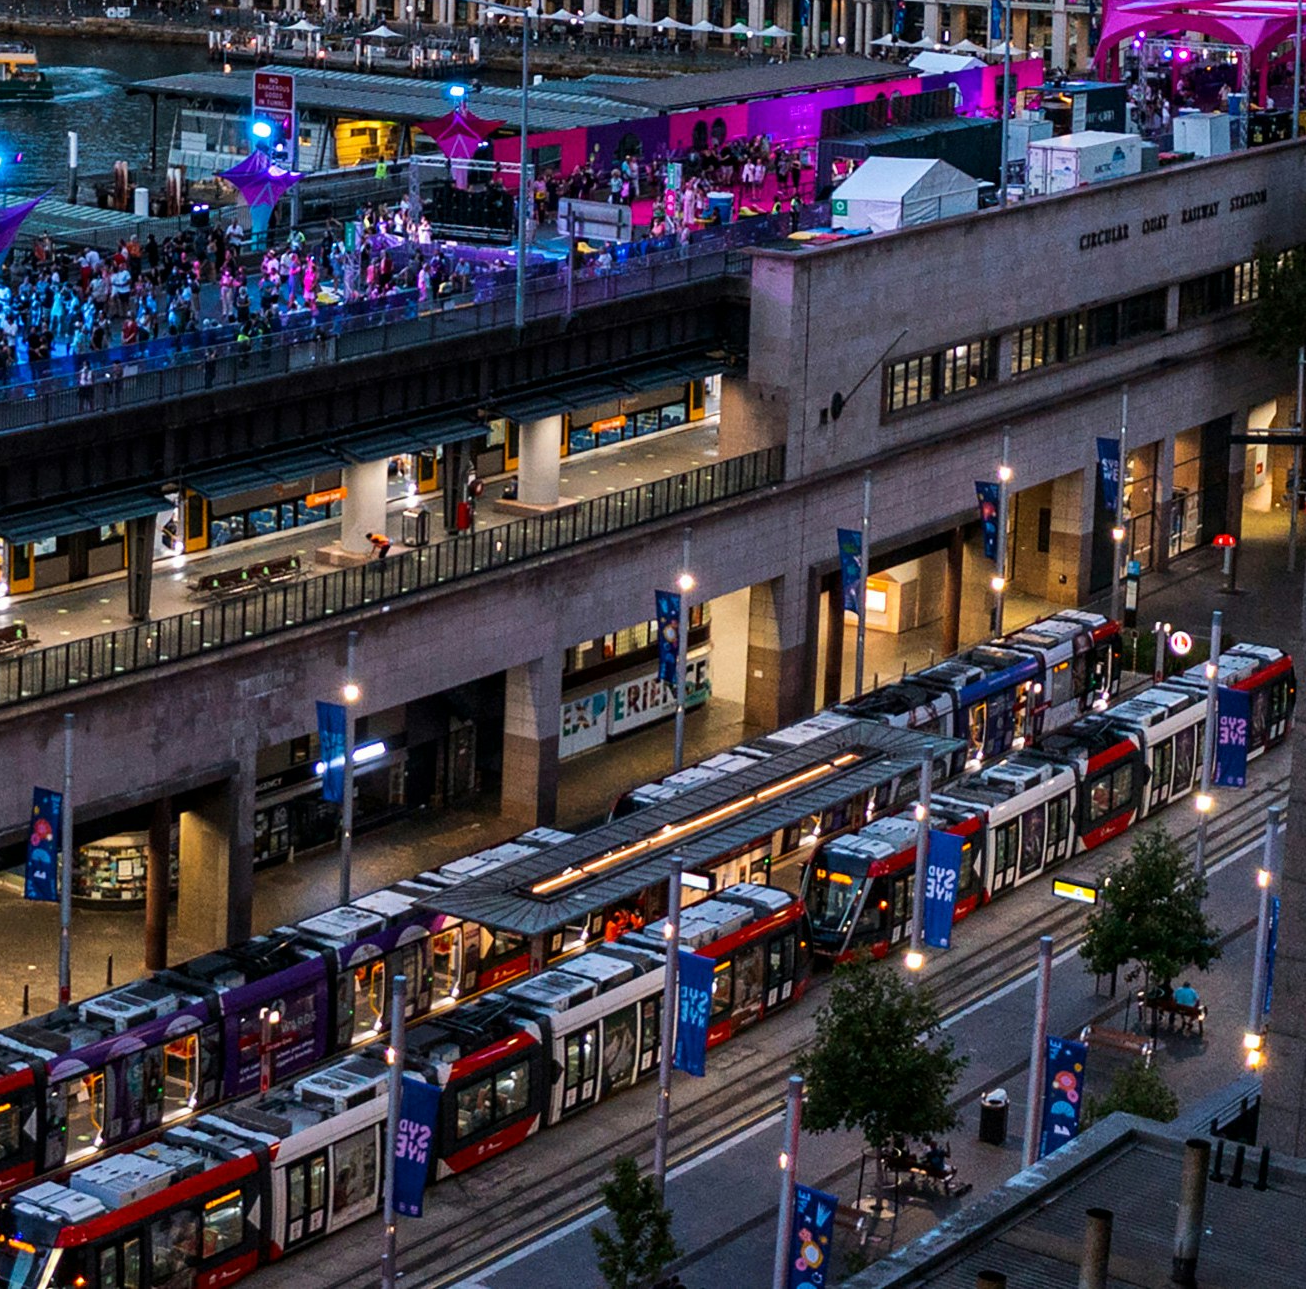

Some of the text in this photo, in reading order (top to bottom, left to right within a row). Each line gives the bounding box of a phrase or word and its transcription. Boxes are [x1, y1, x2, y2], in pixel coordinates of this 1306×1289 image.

[268, 77, 279, 85] NO
[258, 83, 290, 93] DANGEROUS
[1079, 189, 1268, 251] CIRCULAR QUAY RAILWAY STATION
